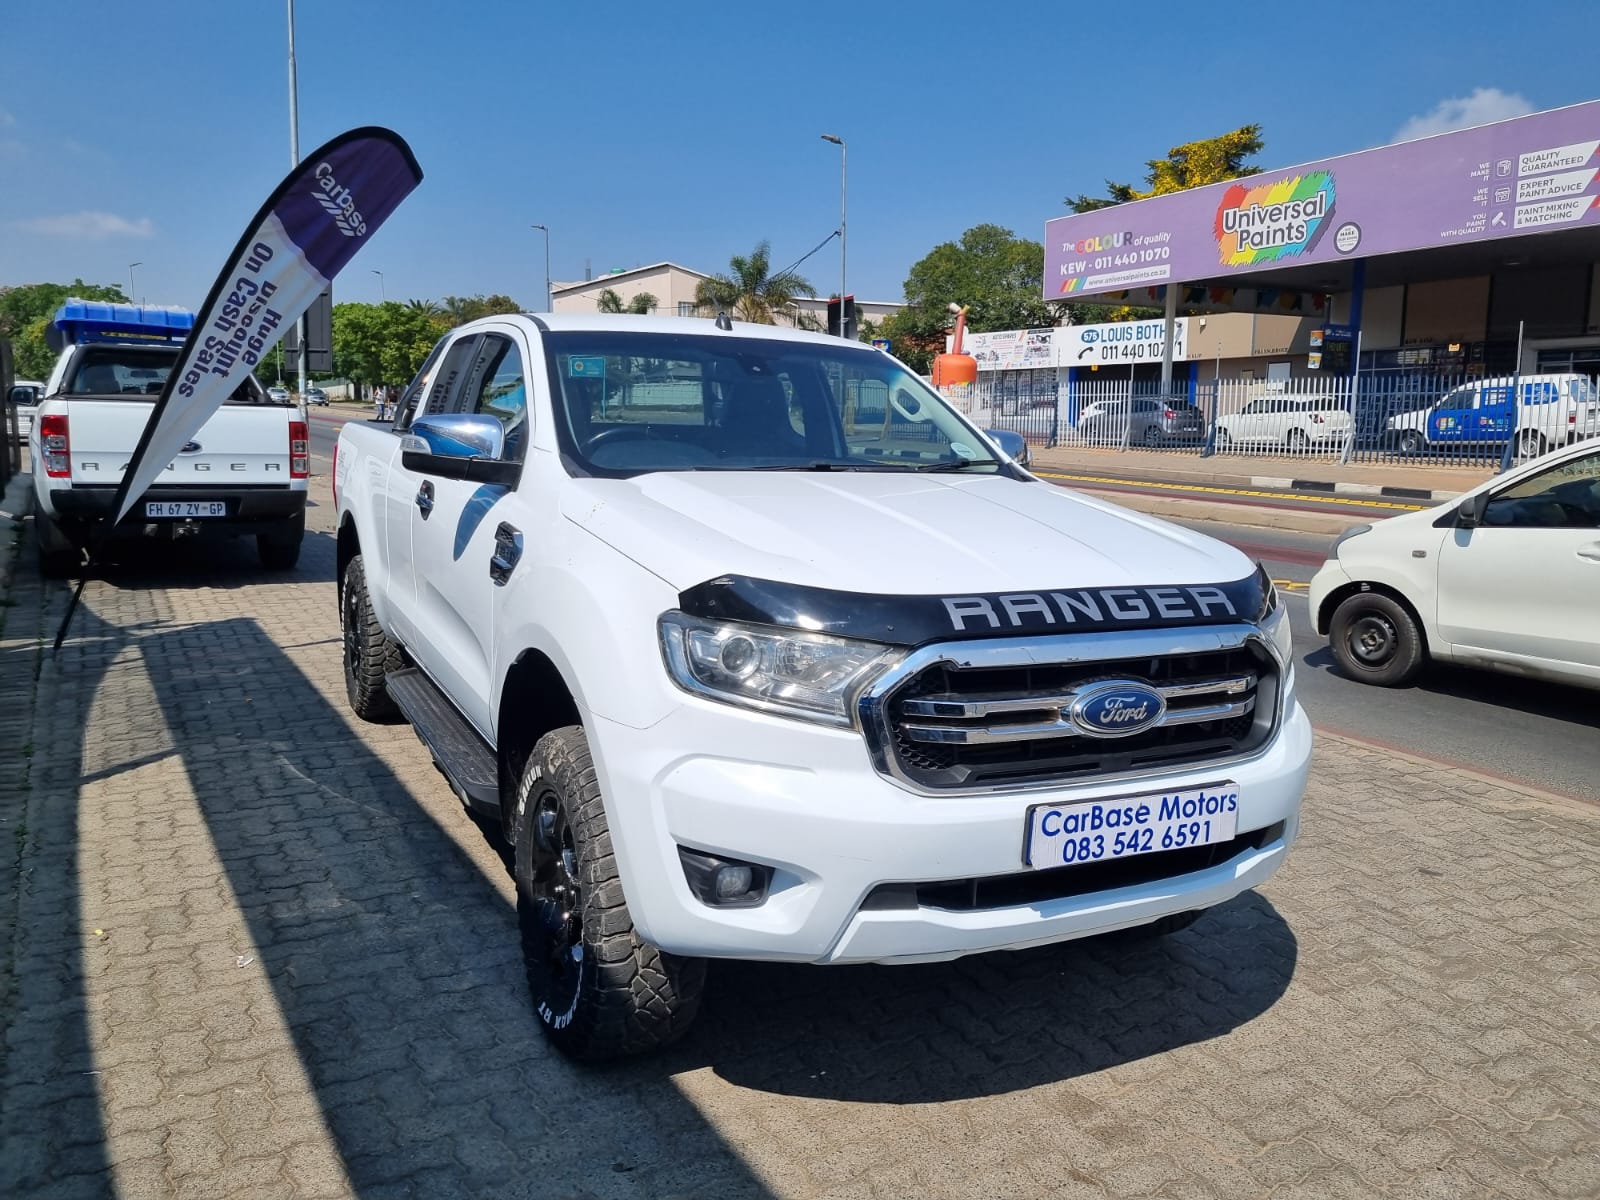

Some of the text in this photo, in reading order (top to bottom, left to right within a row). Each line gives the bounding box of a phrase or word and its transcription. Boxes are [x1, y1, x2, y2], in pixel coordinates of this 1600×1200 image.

[1521, 156, 1583, 173] GUARANTEED
[1522, 151, 1560, 163] QUALITY
[1470, 169, 1490, 177] MAKE
[1520, 178, 1554, 190] EXPERT
[315, 162, 367, 237] Carbase
[1519, 183, 1582, 199] PAINT ADVICE
[1225, 193, 1324, 231] Universal
[1518, 201, 1579, 216] PAINT MIXING
[1525, 211, 1572, 224] MATCHING
[1063, 232, 1171, 254] The COLOUR of quality
[1239, 223, 1305, 250] Paints
[1458, 226, 1486, 236] QUALITY
[245, 242, 274, 273] On
[1060, 261, 1086, 276] KEW
[1095, 257, 1112, 269] 011
[1114, 253, 1137, 267] 440
[1140, 247, 1170, 262] 1070
[214, 277, 259, 332] Cash
[212, 281, 278, 378] Discount
[242, 308, 283, 366] Huge
[1101, 324, 1166, 343] LOUIS BOTH
[1102, 345, 1118, 360] 011
[1122, 343, 1144, 358] 440
[178, 336, 224, 398] Sales
[149, 503, 223, 516] FH 67 ZY GP
[942, 586, 1237, 631] RANGER
[1100, 696, 1149, 724] Ford
[1041, 791, 1237, 837] CarBase Motors
[1062, 821, 1211, 864] 083 542 6591
